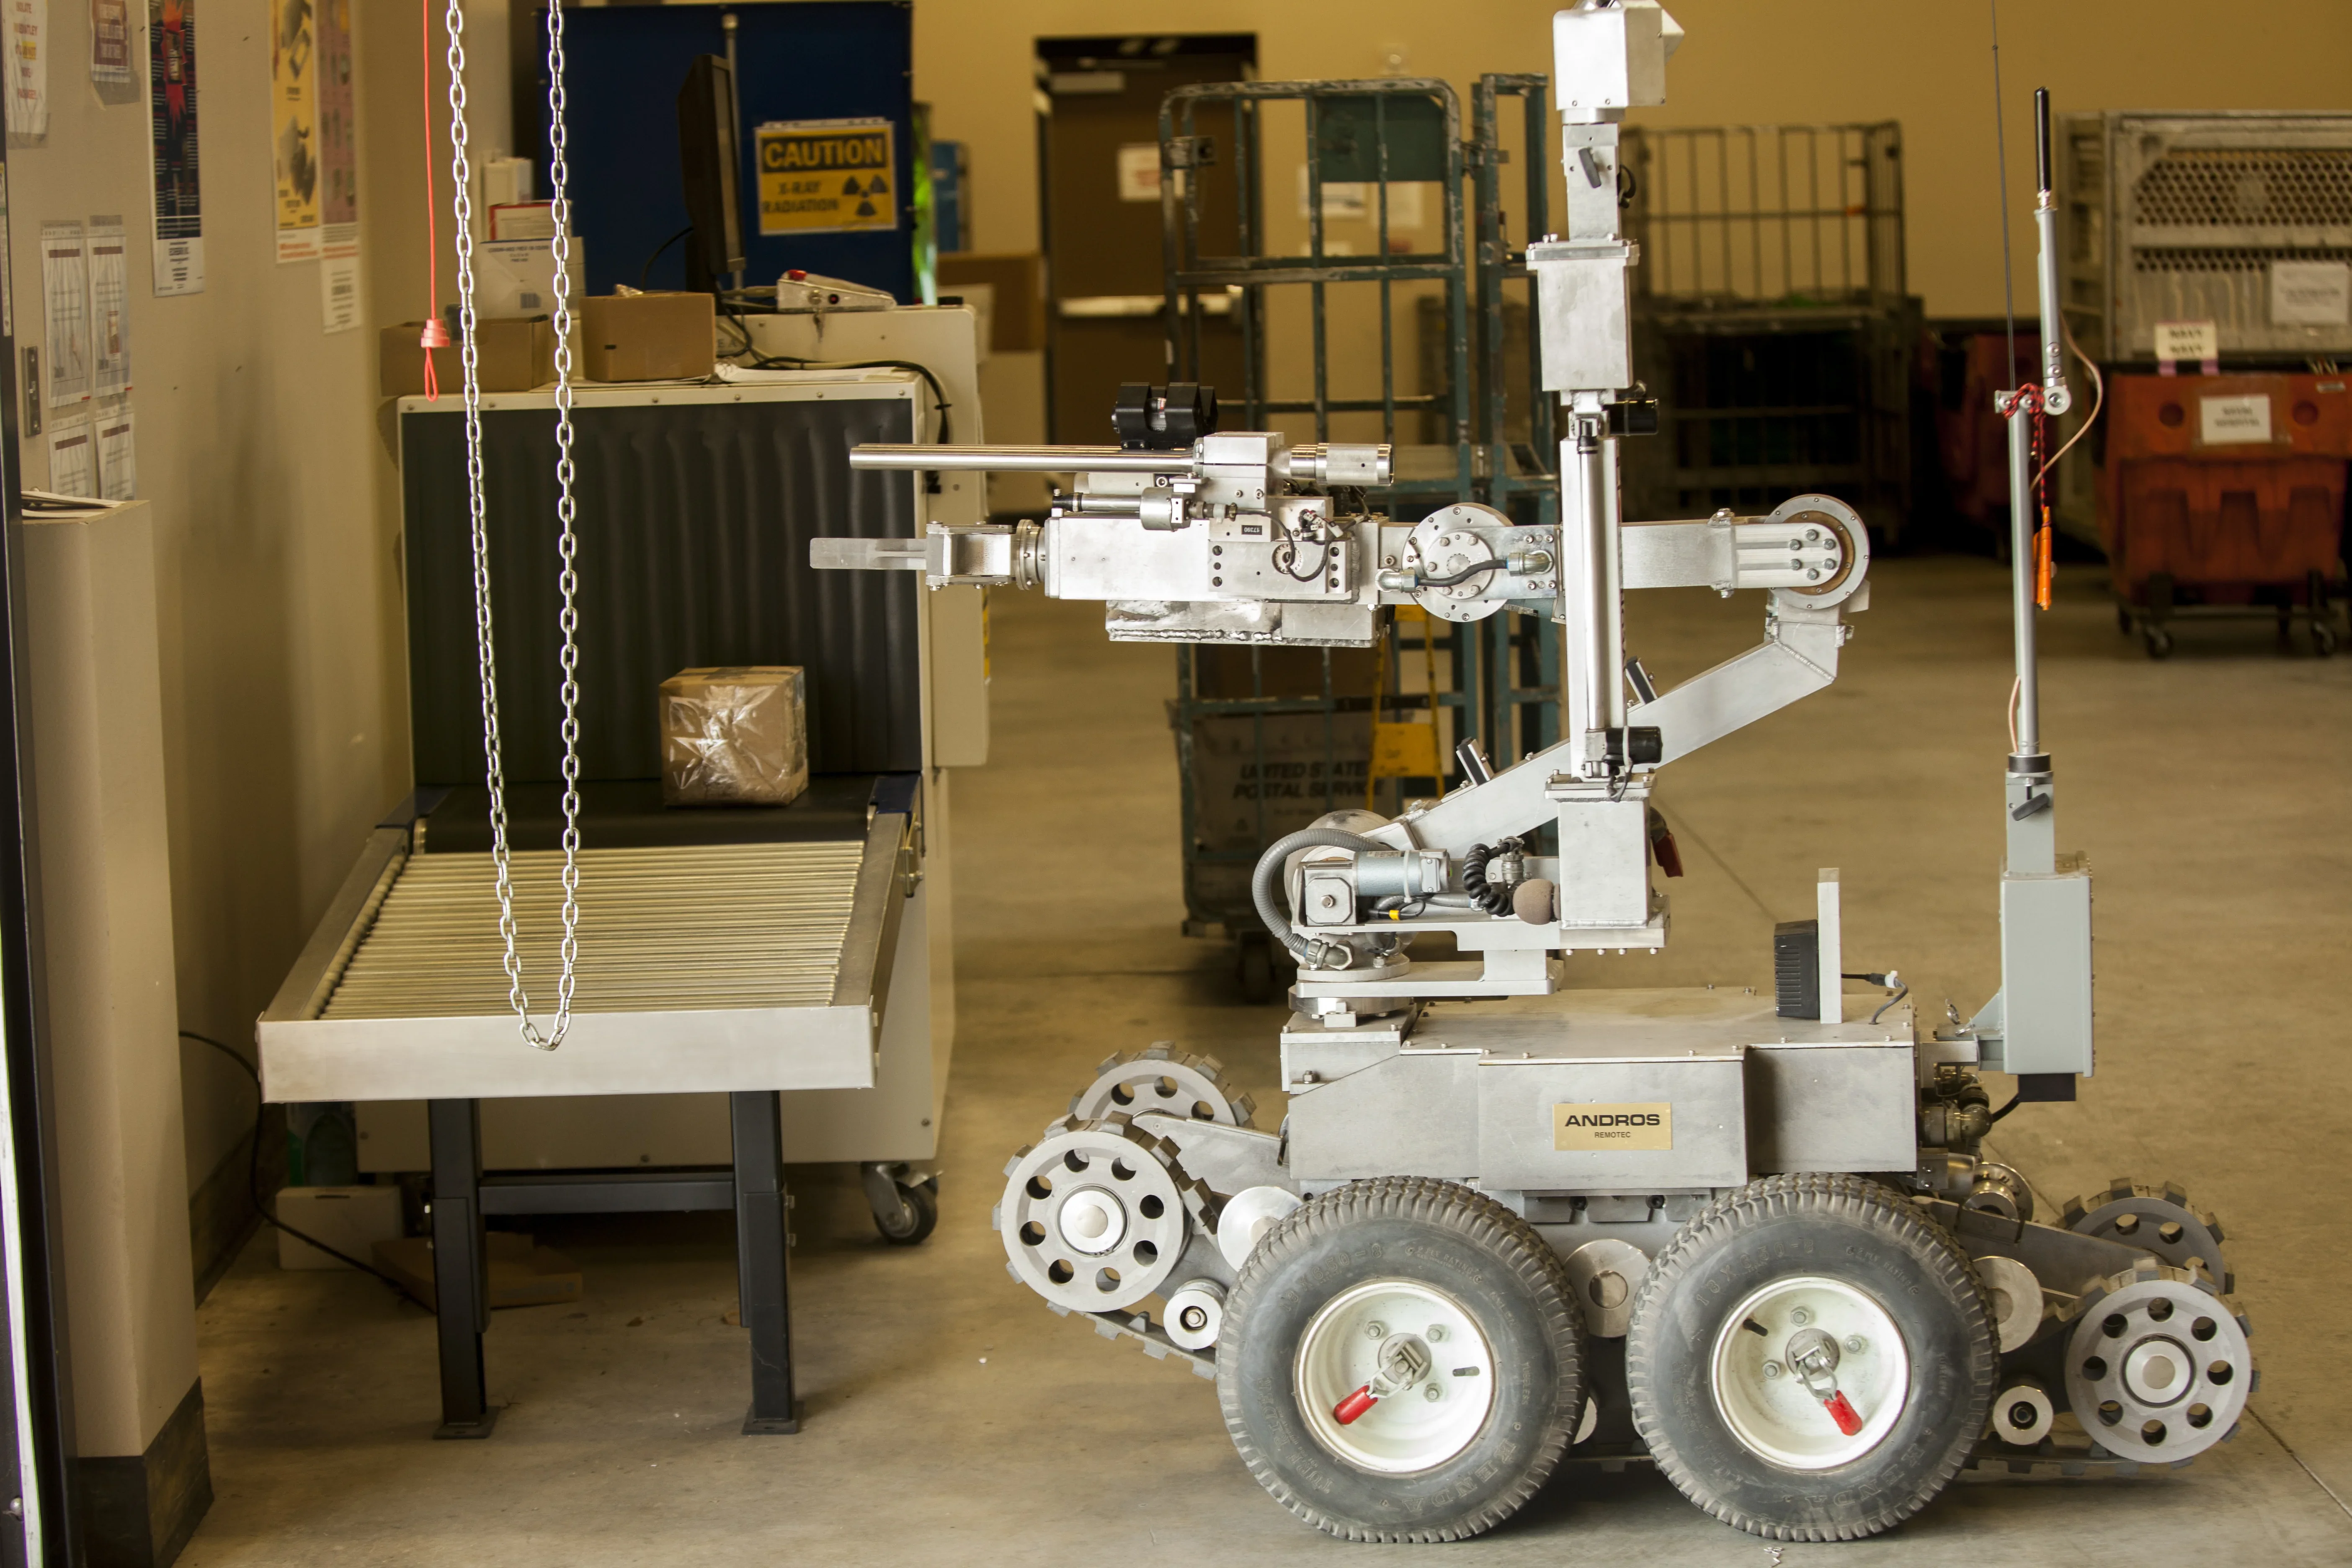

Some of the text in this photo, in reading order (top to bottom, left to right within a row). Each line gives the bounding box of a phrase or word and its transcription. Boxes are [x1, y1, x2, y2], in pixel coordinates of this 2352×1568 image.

[764, 139, 883, 168] CAUTION
[778, 180, 822, 195] X-RAY
[763, 197, 840, 214] RADIATION
[1565, 1114, 1660, 1127] ANDROS
[1444, 1254, 1474, 1274] RATING
[1522, 1361, 1532, 1406] TUBELESS
[1257, 1377, 1291, 1451] RIDER
[1402, 1438, 1516, 1512] KENDA
